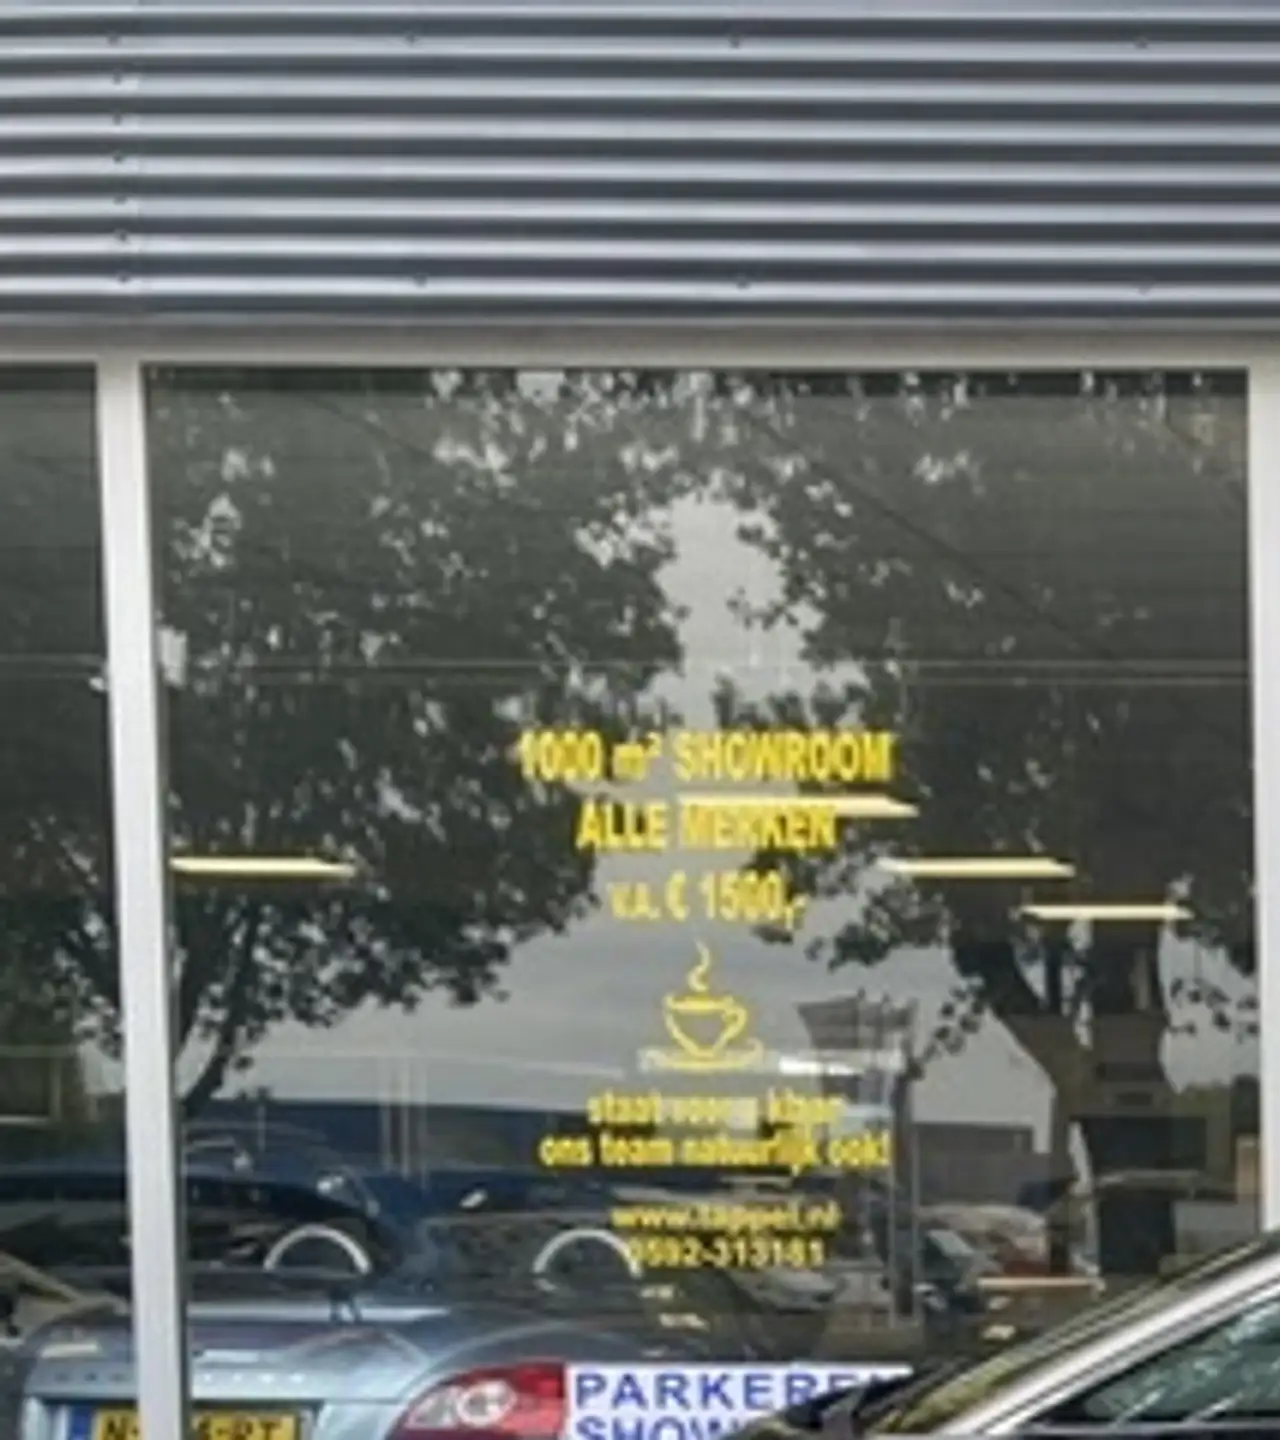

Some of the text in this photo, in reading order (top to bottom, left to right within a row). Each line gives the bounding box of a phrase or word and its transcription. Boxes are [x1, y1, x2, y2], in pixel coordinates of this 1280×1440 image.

[520, 731, 602, 781] 1000
[674, 731, 893, 782] SHOWROOM
[576, 800, 836, 848] ALLE MERKEN
